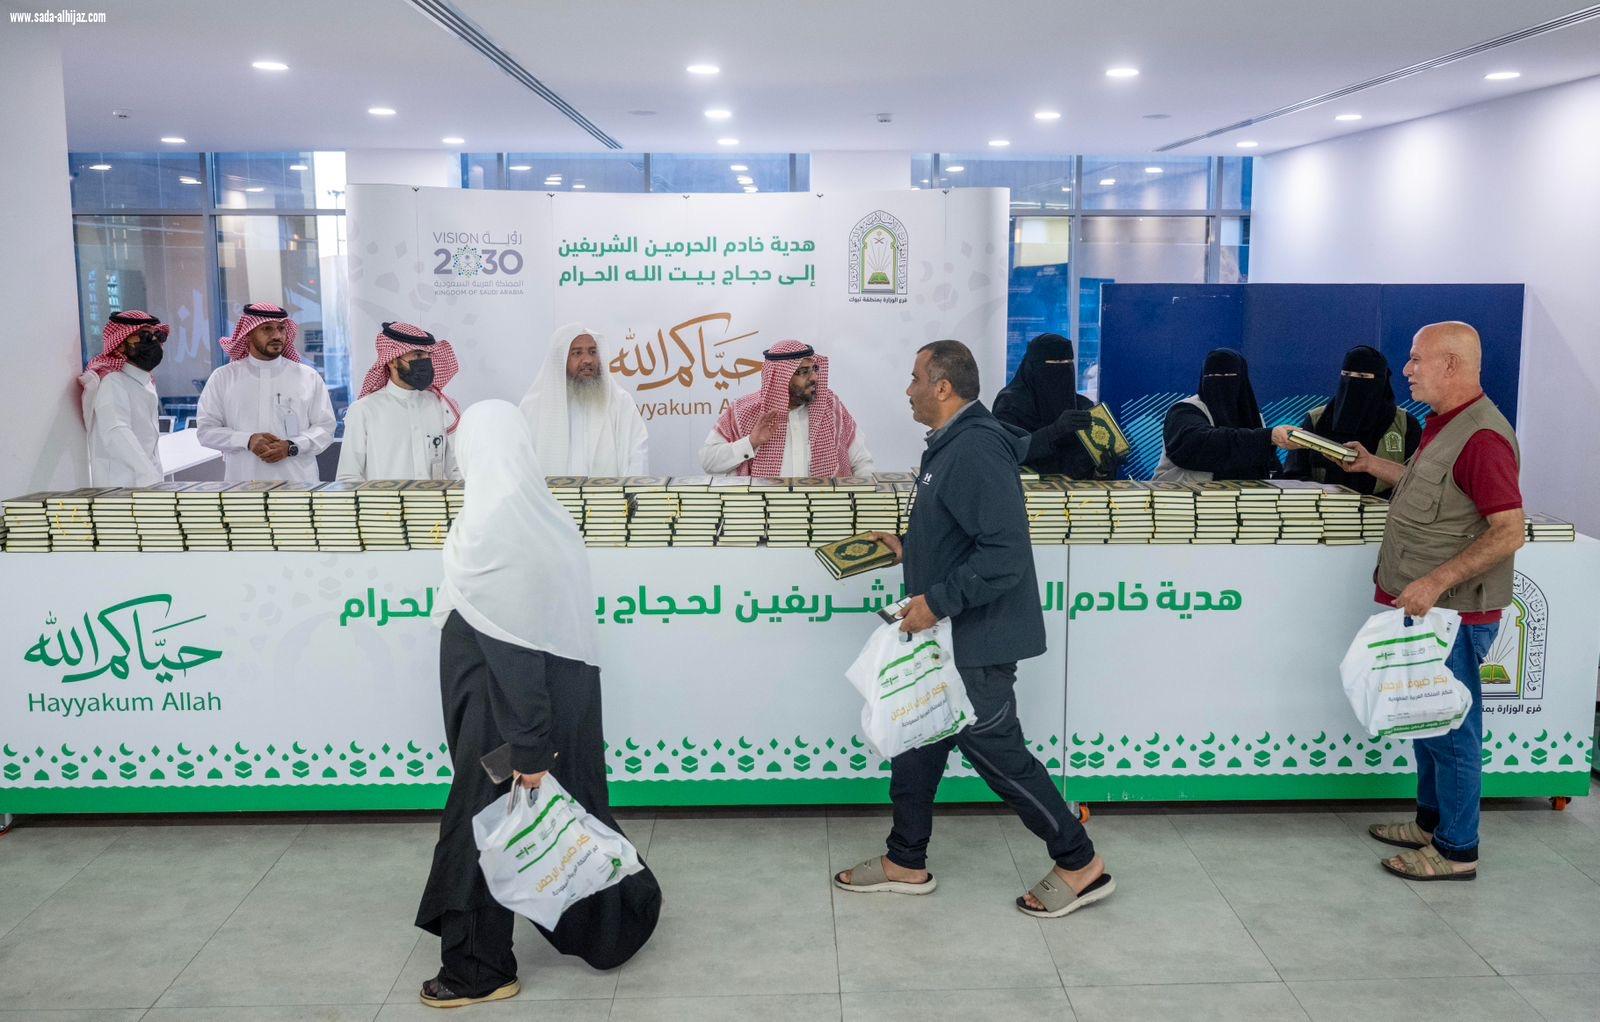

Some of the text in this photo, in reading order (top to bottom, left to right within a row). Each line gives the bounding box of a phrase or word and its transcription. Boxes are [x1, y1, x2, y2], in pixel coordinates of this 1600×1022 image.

[433, 231, 479, 244] VISION
[558, 234, 816, 257] هدية خادم الحرمين الشريفين
[559, 264, 816, 287] إلى حجاج بيت الله الحرام
[636, 399, 712, 421] yyakum
[339, 587, 439, 627] لحرام
[612, 585, 722, 624] لحجاج
[735, 578, 906, 624] لشريفين
[1069, 581, 1149, 621] خادم
[1156, 580, 1244, 621] هدية
[28, 692, 222, 718] Hayyakum Allah
[1497, 704, 1524, 715] الوزارة
[1525, 704, 1542, 715] فرع
